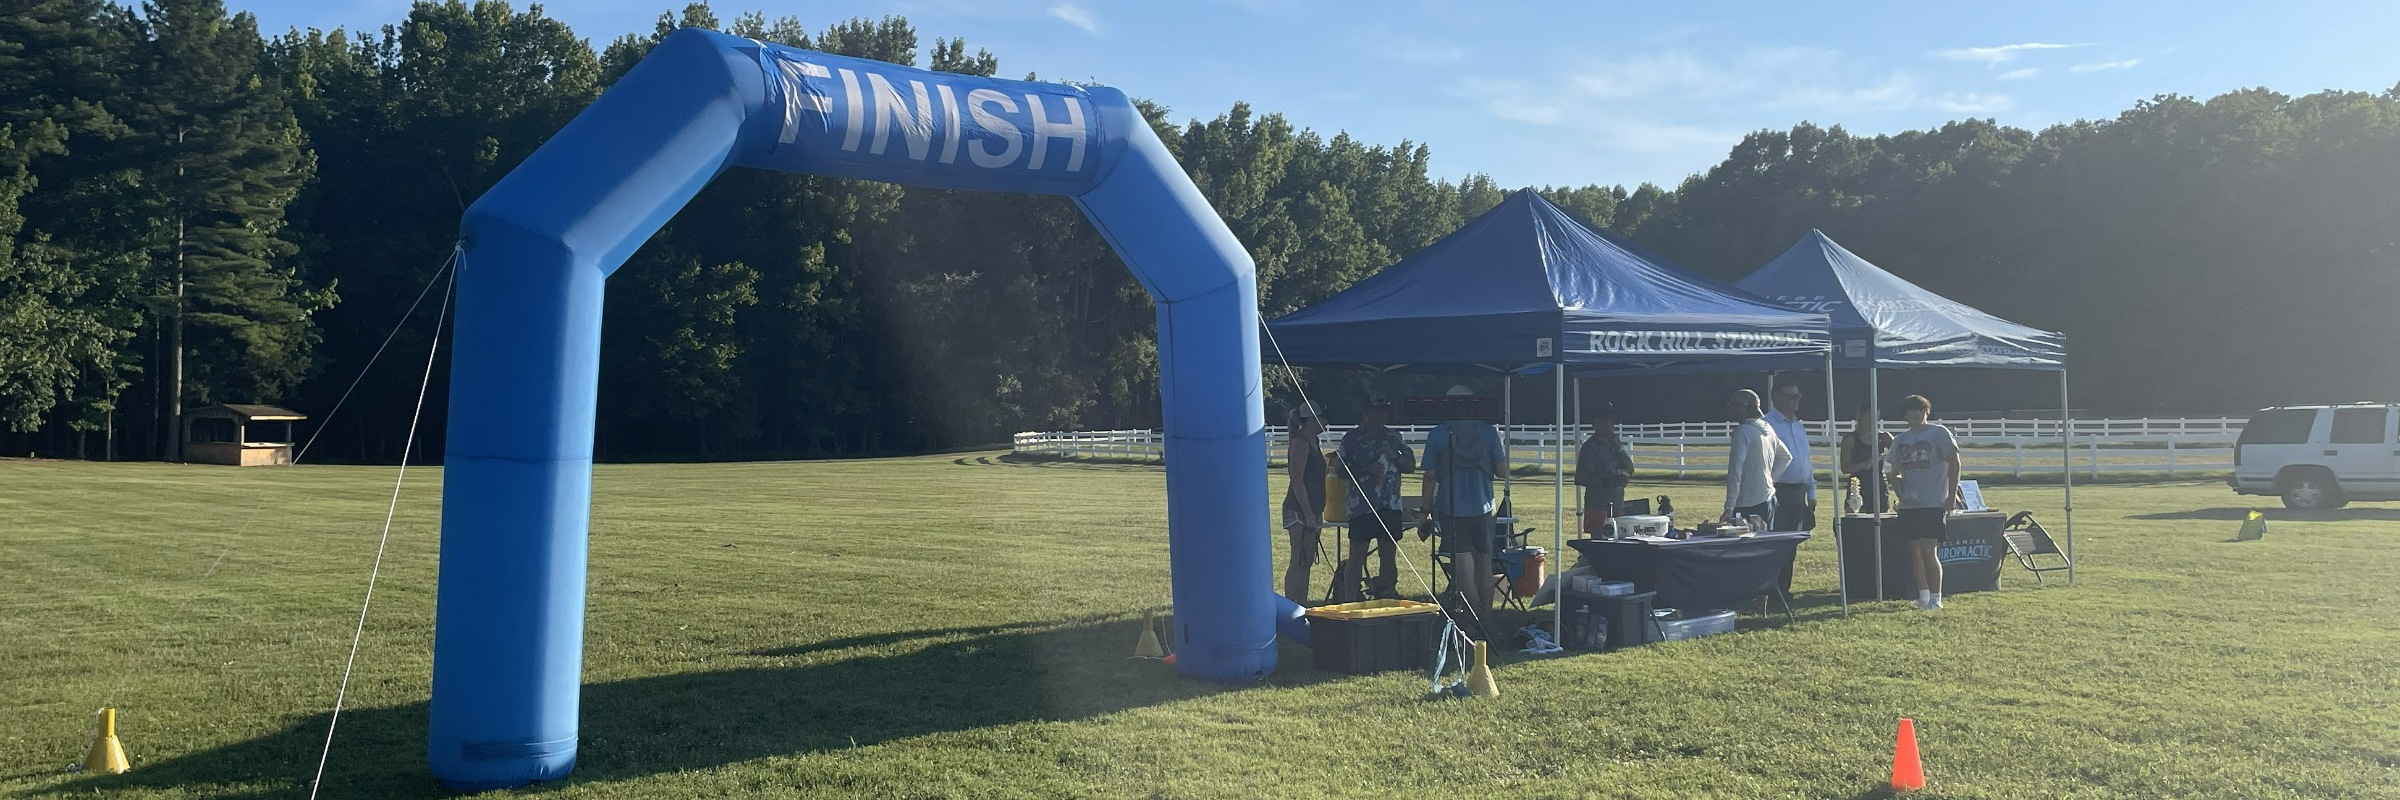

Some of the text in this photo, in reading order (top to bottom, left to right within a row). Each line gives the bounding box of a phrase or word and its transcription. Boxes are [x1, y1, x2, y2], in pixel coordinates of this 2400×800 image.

[777, 60, 1088, 172] FINISH
[1589, 331, 1653, 352] ROCK
[1659, 331, 1708, 350] HILL
[1712, 331, 1810, 350] STRIDERS
